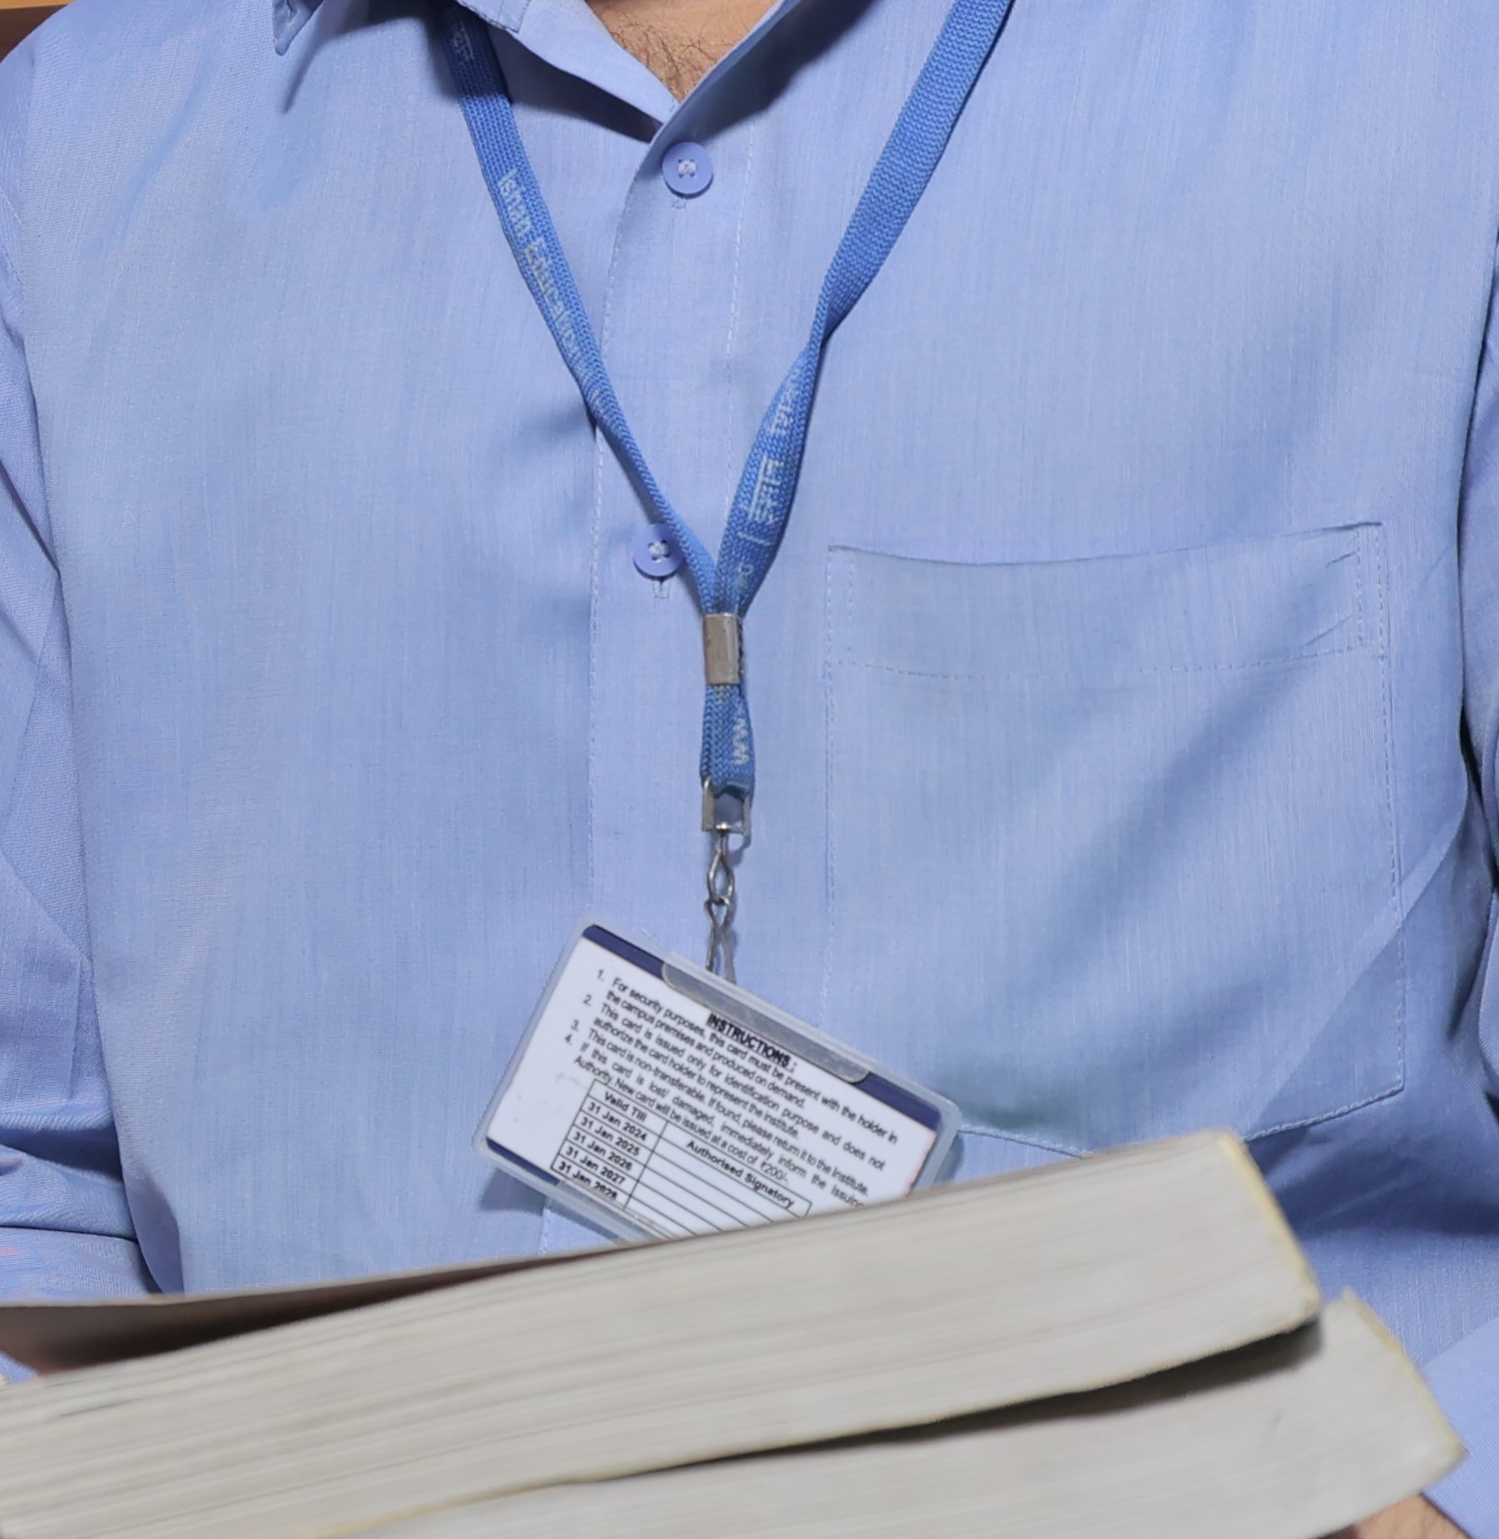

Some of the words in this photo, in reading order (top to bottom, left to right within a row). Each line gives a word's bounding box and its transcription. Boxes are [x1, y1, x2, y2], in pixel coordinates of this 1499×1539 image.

[496, 167, 537, 238] Ishan
[597, 969, 603, 978] 1.
[612, 977, 628, 992] For
[629, 989, 662, 1013] security
[663, 1009, 704, 1037] purposes,
[709, 1032, 724, 1047] this
[726, 1044, 747, 1059] card
[748, 1055, 771, 1072] must
[771, 1067, 783, 1080] be
[784, 1076, 820, 1099] present
[821, 1097, 839, 1109] with
[841, 1106, 856, 1120] the
[858, 1115, 886, 1136] holder
[887, 1132, 897, 1143] in
[606, 990, 620, 1004] the
[621, 1000, 654, 1023] campus
[655, 1019, 694, 1046] premises
[695, 1042, 713, 1056] and
[712, 1052, 755, 1079] produced
[754, 1075, 767, 1086] on
[767, 1082, 804, 1107] demand.
[707, 1014, 789, 1066] INSTRUCTIONS
[564, 1034, 572, 1042] 4.
[580, 1042, 589, 1051] If
[591, 1049, 607, 1064] this
[612, 1062, 632, 1077] card
[636, 1075, 644, 1085] is
[648, 1081, 668, 1098] lost/
[672, 1096, 714, 1124] damaged,
[721, 1124, 772, 1159] immediately
[777, 1156, 806, 1176] inform
[811, 1174, 826, 1188] the
[570, 1019, 579, 1030] 3.
[589, 1028, 606, 1046] This
[606, 1042, 627, 1057] card
[626, 1052, 634, 1062] is
[635, 1058, 704, 1101] non-transferable.
[708, 1097, 717, 1106] If
[715, 1101, 741, 1124] found,
[742, 1119, 772, 1140] please
[773, 1136, 799, 1155] return
[799, 1150, 807, 1160] it
[806, 1153, 816, 1165] to
[816, 1159, 831, 1173] the
[831, 1168, 867, 1194] Institute.
[574, 1055, 612, 1083] Authority.
[615, 1078, 634, 1094] New
[635, 1091, 655, 1107] card
[655, 1103, 670, 1114] will
[669, 1109, 681, 1122] be
[682, 1118, 711, 1138] issued
[710, 1135, 720, 1143] at
[720, 1140, 727, 1148] a
[727, 1144, 747, 1159] cost
[746, 1155, 758, 1164] of
[583, 994, 591, 1005] 2.
[601, 1003, 618, 1020] This
[621, 1018, 642, 1033] card
[644, 1030, 652, 1039] is
[655, 1037, 684, 1057] issued
[687, 1054, 705, 1070] only
[709, 1064, 721, 1077] for
[724, 1076, 778, 1109] identification
[781, 1108, 818, 1132] purpose
[821, 1130, 840, 1145] and
[843, 1142, 865, 1159] does
[868, 1156, 885, 1170] not
[593, 1018, 633, 1043] authorize
[634, 1038, 648, 1052] the
[648, 1048, 669, 1063] card
[669, 1058, 696, 1078] holder
[696, 1074, 706, 1085] to
[706, 1081, 748, 1108] represent
[748, 1103, 762, 1117] the
[763, 1113, 797, 1137] institute.
[605, 1091, 629, 1111] Valid
[631, 1106, 646, 1121] Till
[573, 1131, 586, 1143] 31
[587, 1141, 605, 1155] Jan
[608, 1152, 631, 1170] 2026
[581, 1116, 593, 1128] 31
[594, 1126, 613, 1140] Jan
[615, 1137, 639, 1155] 2025
[588, 1102, 600, 1114] 31
[602, 1111, 620, 1125] Jan
[622, 1122, 646, 1140] 2024
[566, 1146, 578, 1158] 31
[580, 1156, 598, 1170] Jan
[600, 1166, 624, 1183] 2027
[687, 1140, 743, 1176] Authorised
[745, 1173, 793, 1207] Signatory
